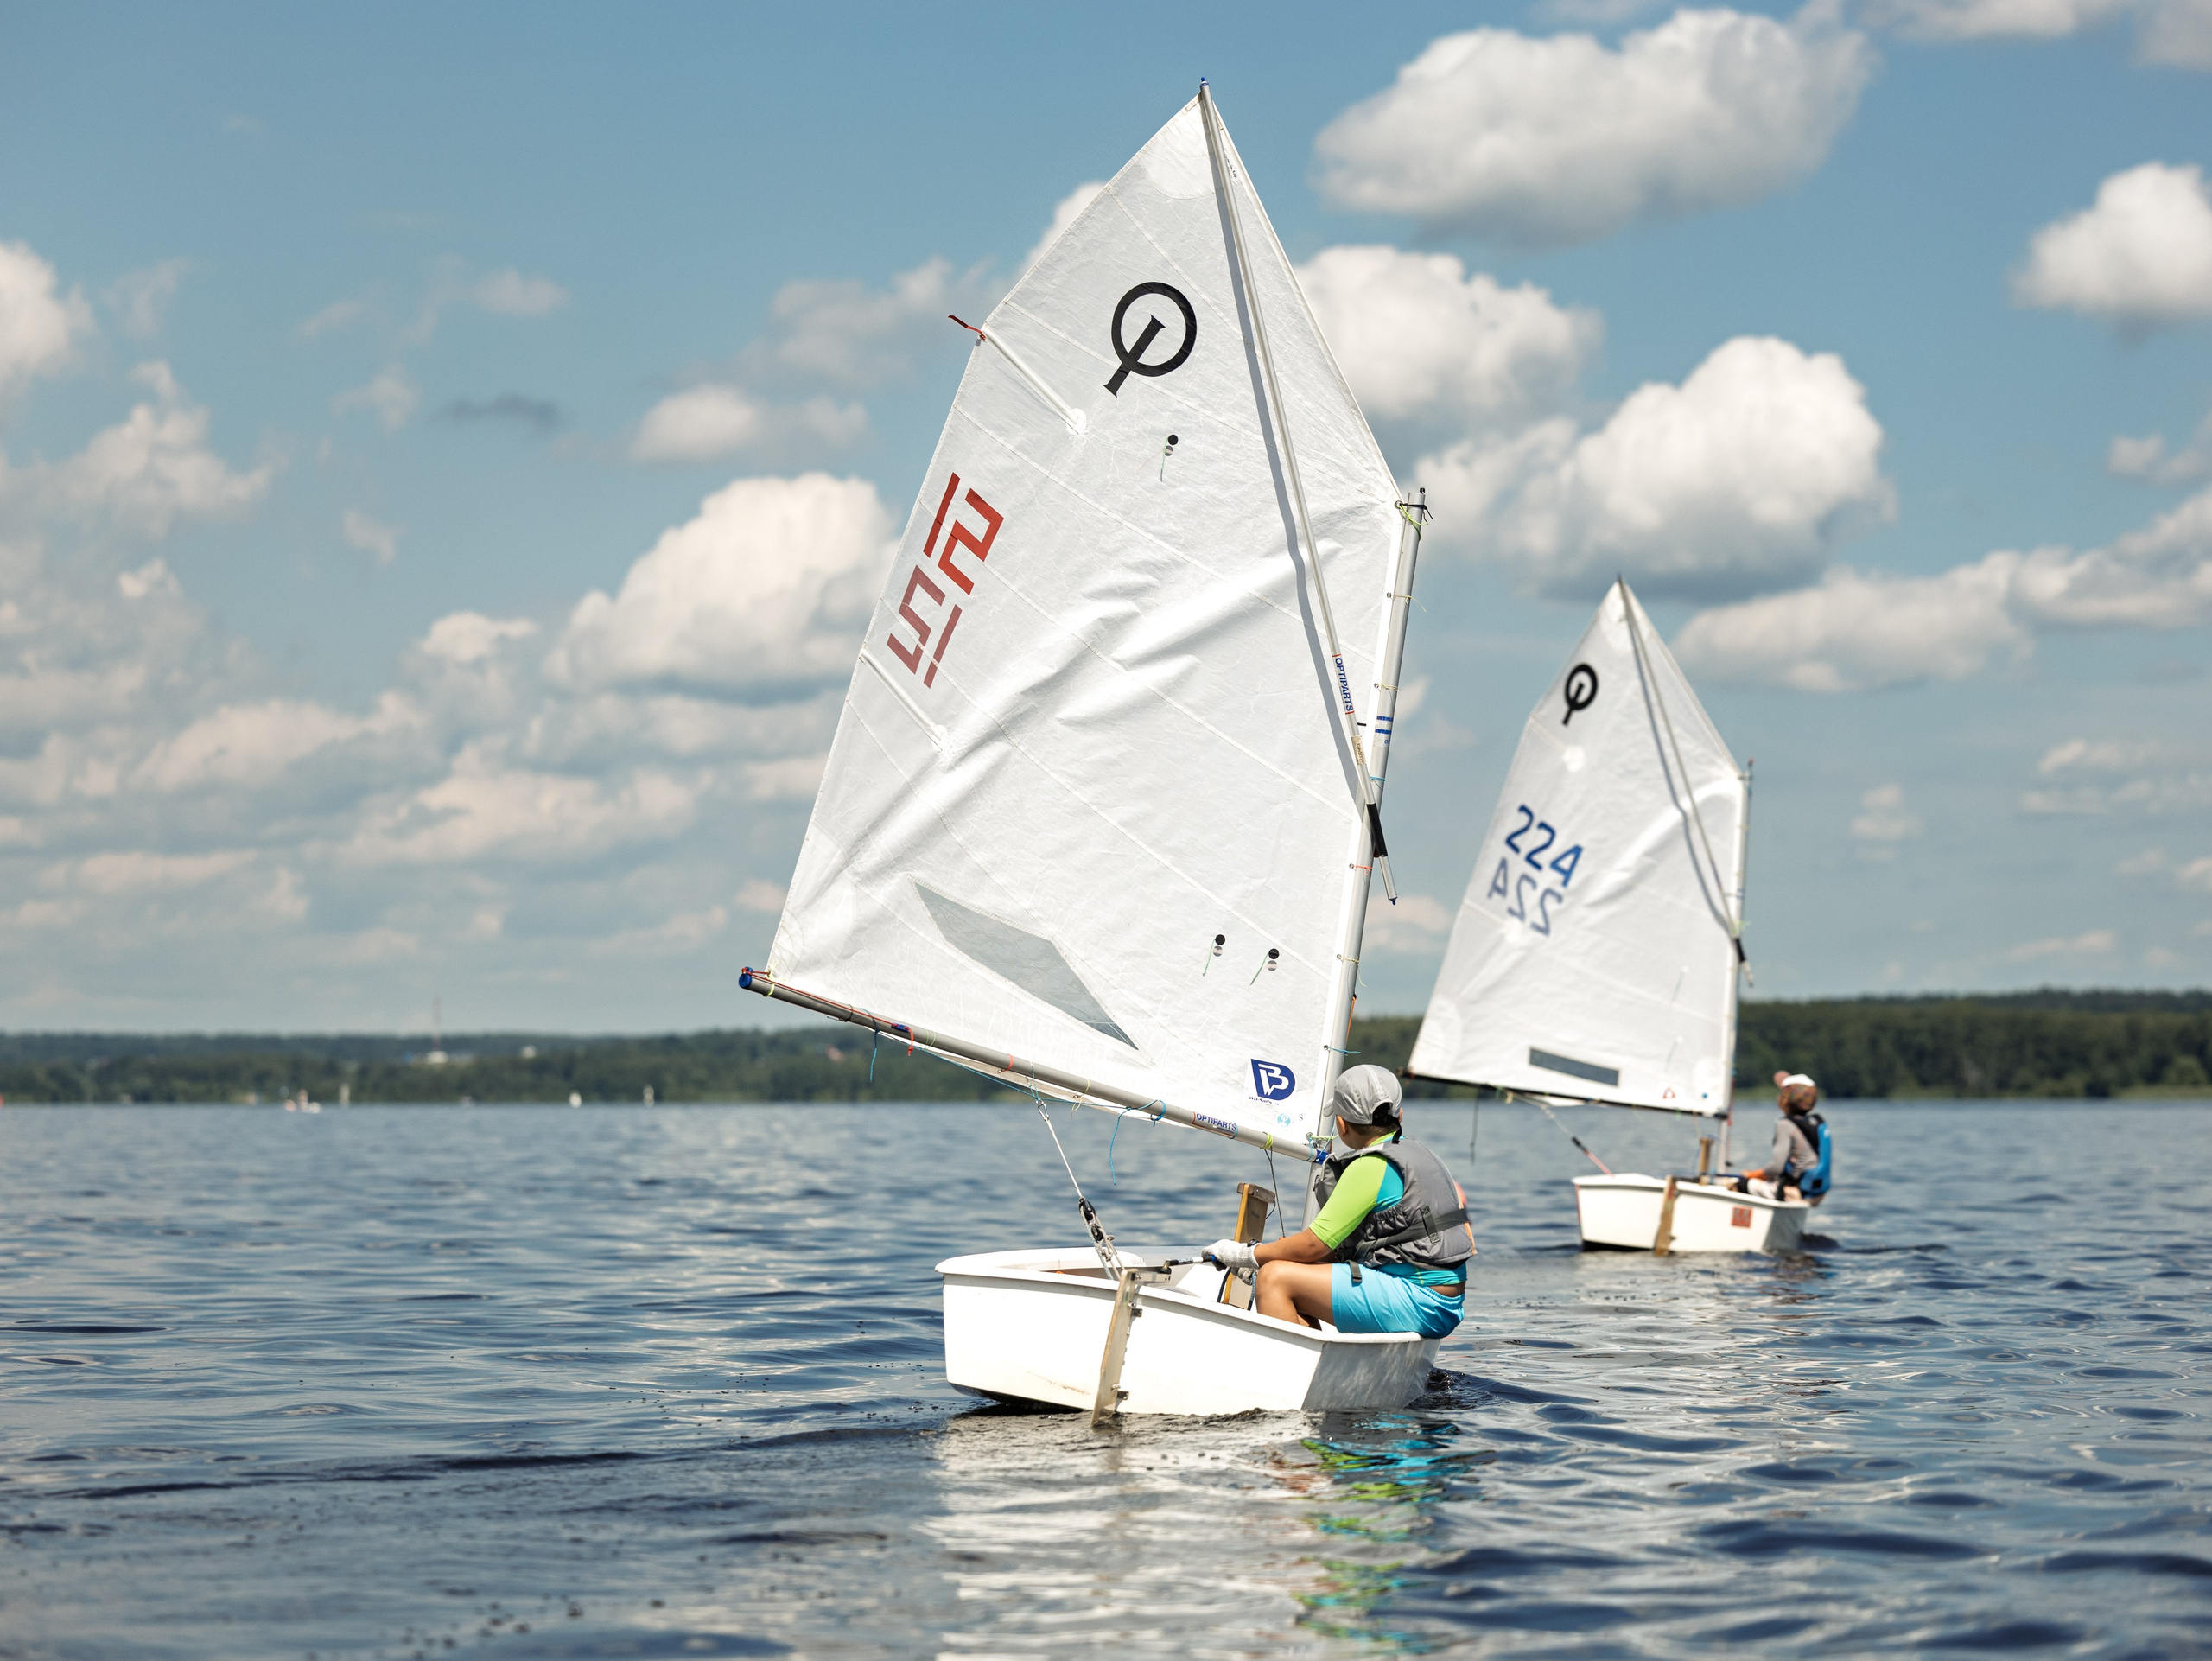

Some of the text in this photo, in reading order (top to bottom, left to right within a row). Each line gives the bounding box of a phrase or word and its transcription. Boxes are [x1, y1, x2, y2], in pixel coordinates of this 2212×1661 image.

[1334, 657, 1354, 712] OPTIPARTS
[1503, 804, 1584, 889] 224
[1196, 1112, 1237, 1131] OPTIPARTS
